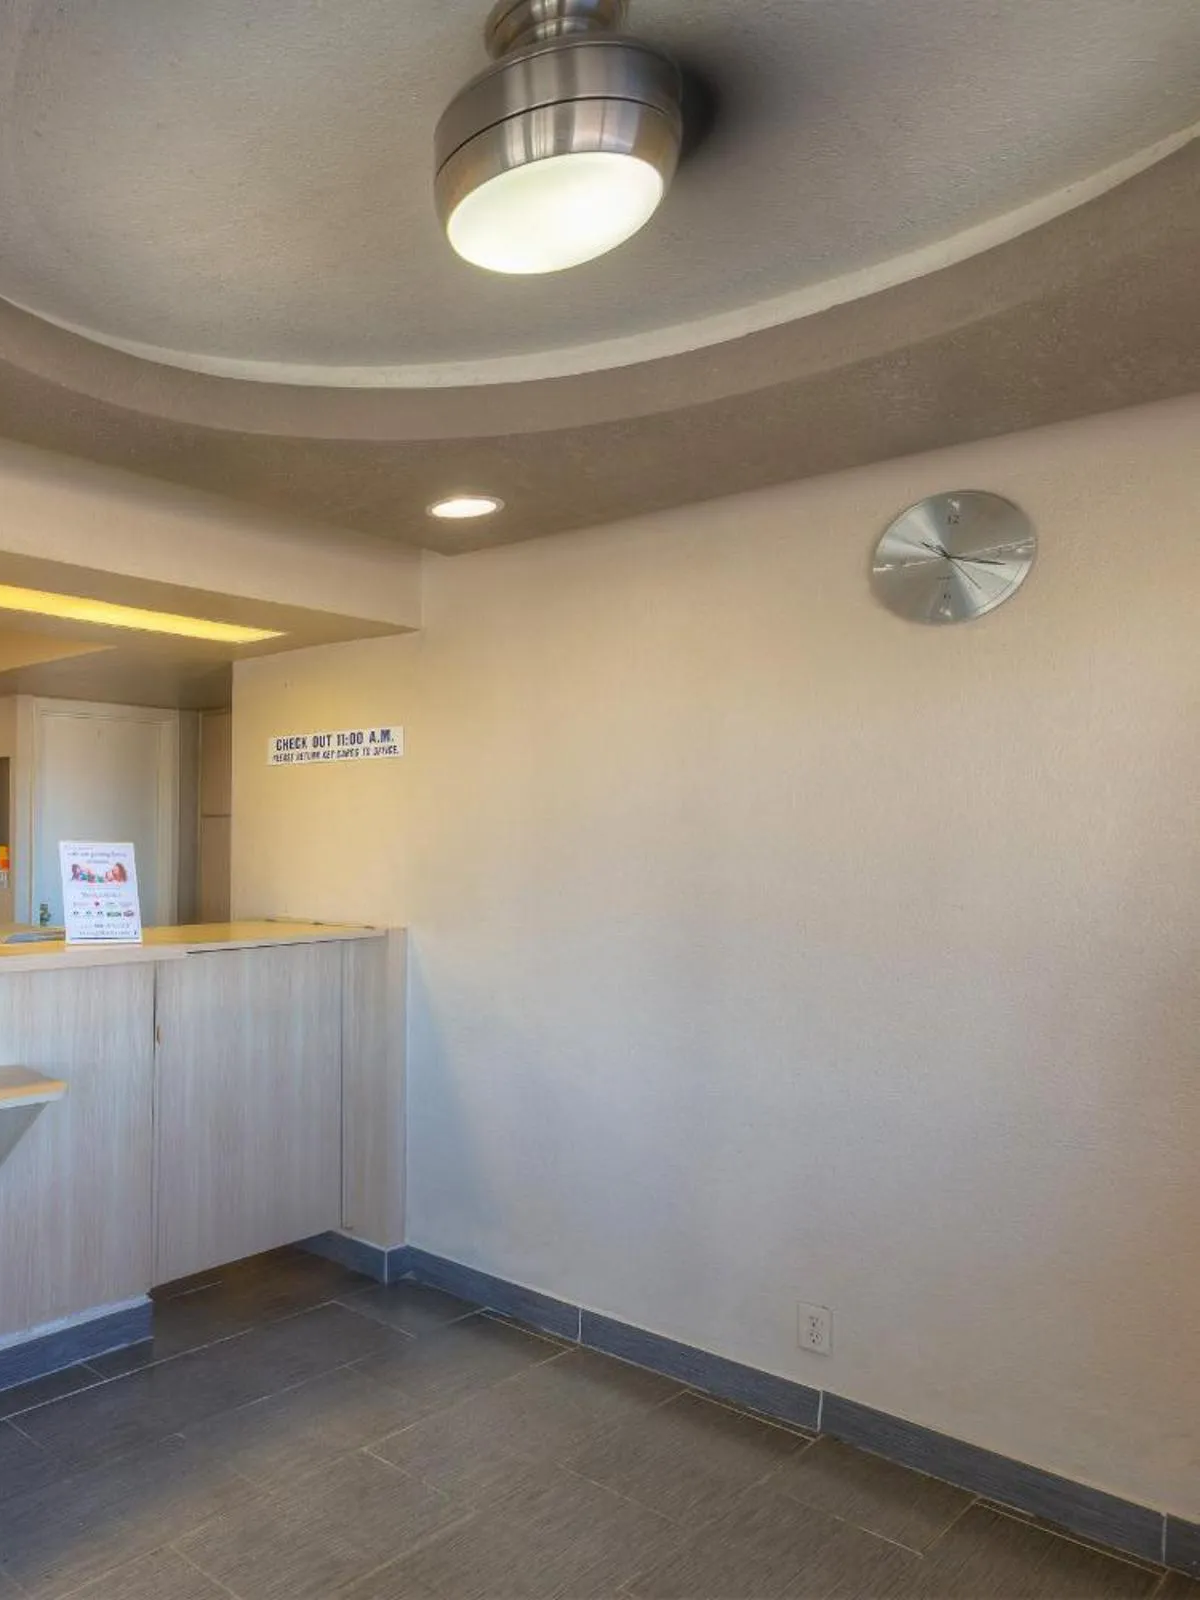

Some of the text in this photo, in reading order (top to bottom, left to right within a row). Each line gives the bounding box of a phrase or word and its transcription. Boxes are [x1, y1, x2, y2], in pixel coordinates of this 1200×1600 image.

[276, 729, 394, 751] CHECK OUT 11:00 A.M.
